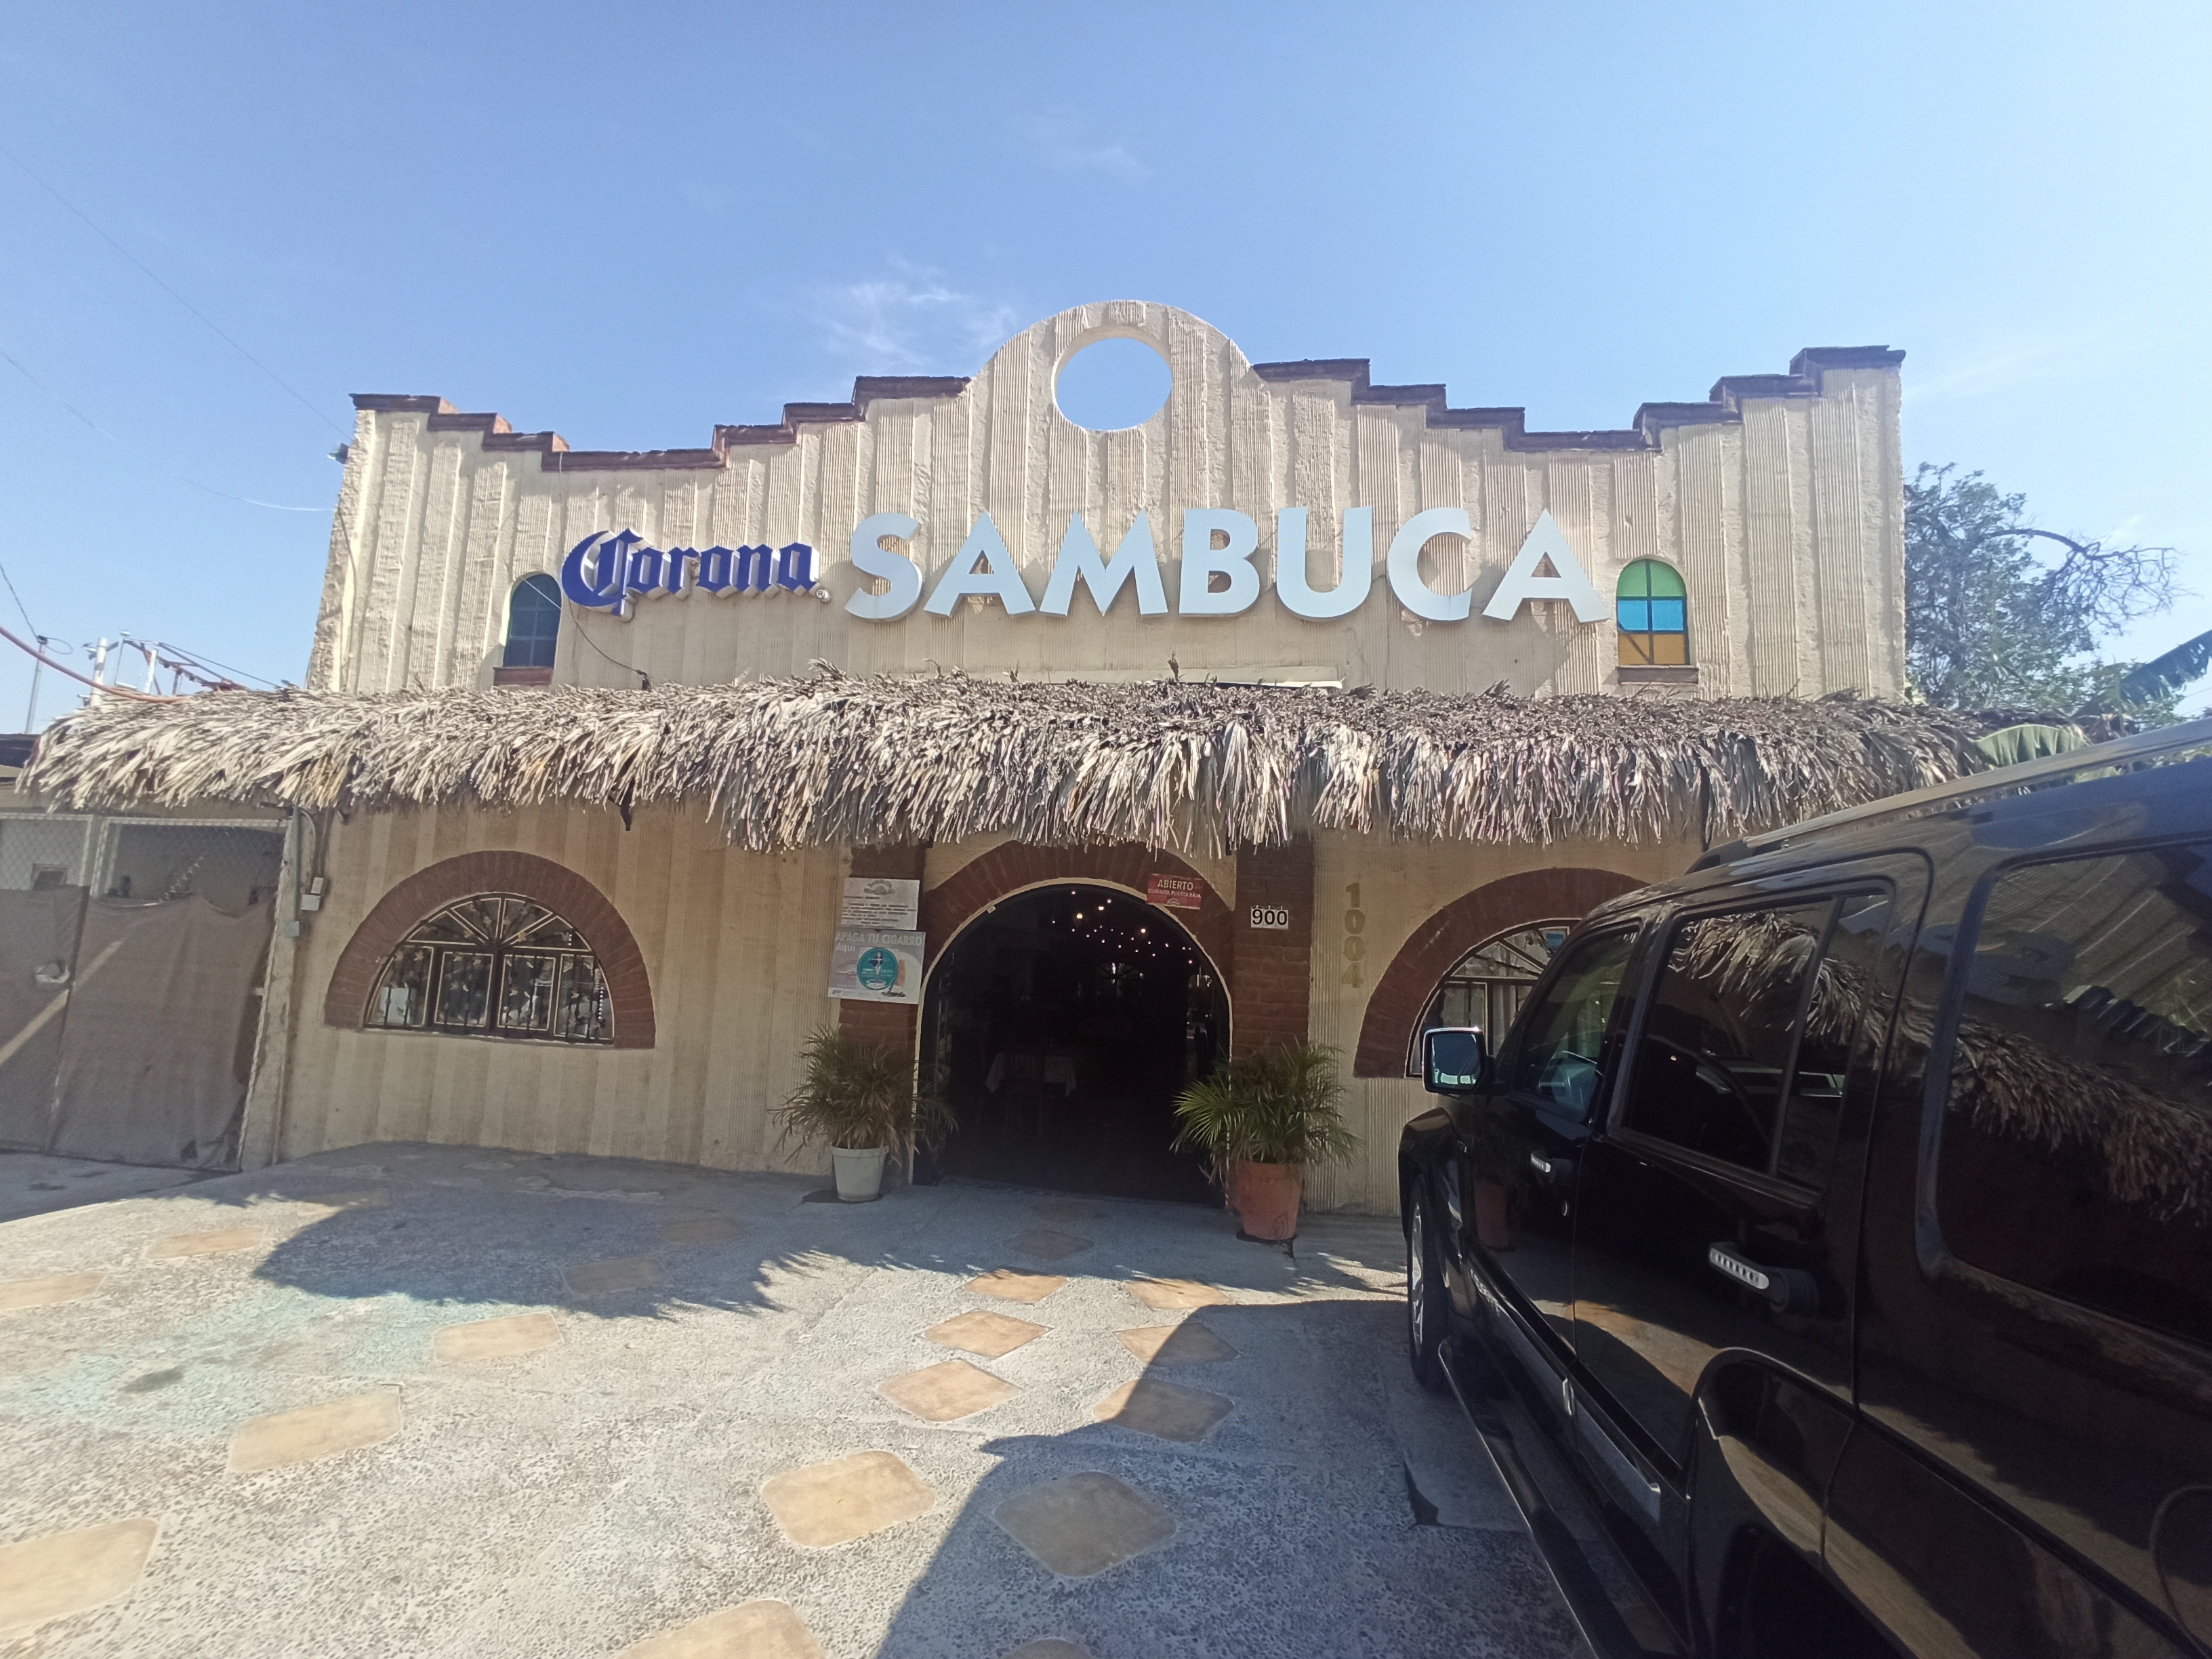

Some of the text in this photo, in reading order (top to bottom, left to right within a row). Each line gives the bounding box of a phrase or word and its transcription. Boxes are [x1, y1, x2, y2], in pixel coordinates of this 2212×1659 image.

[561, 527, 820, 618] Corona
[844, 506, 1611, 623] SAMBUCA
[1157, 879, 1194, 890] ABIERTO
[834, 931, 922, 947] APAGA TU CIGARRO
[1252, 909, 1288, 926] 900
[1341, 882, 1366, 988] 1004
